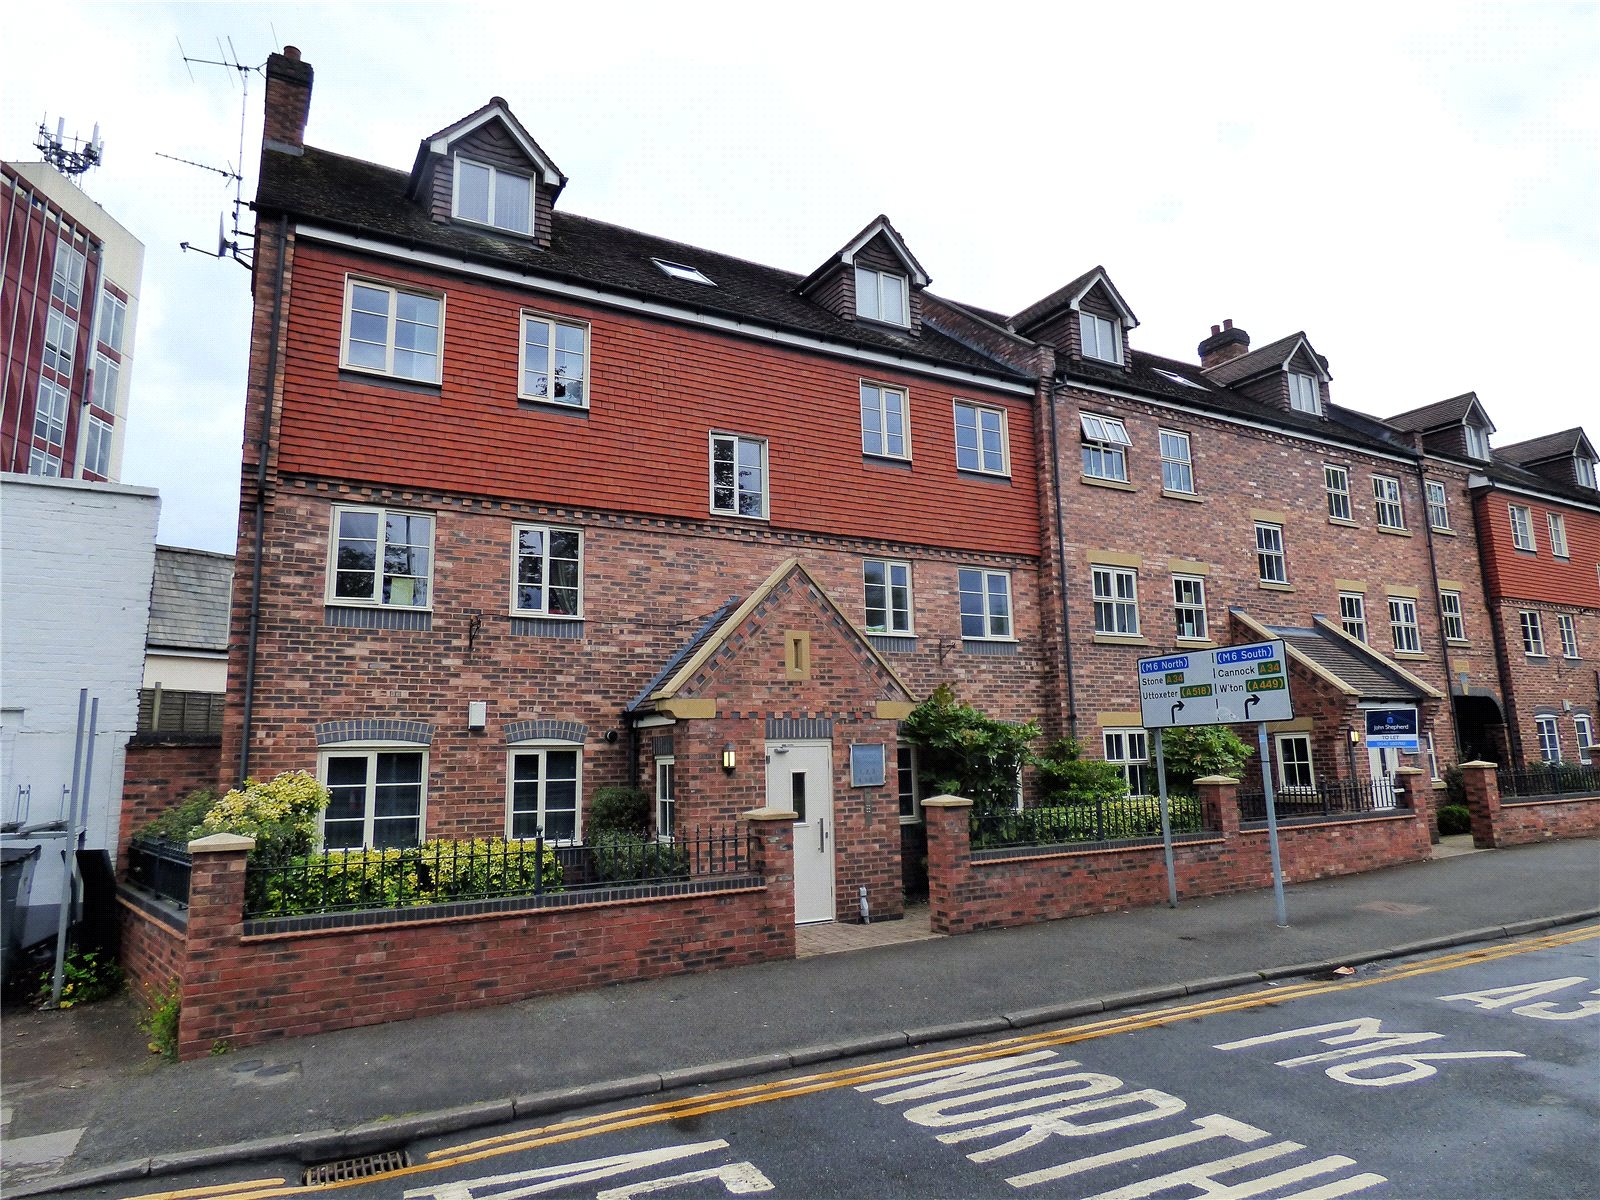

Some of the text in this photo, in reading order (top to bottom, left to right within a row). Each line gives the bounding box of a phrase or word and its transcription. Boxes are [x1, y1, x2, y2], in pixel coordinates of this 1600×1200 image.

[1241, 647, 1272, 660] South)
[1161, 657, 1188, 670] North)
[1218, 663, 1280, 678] Cannock A34
[1142, 674, 1183, 686] Stone A34
[1219, 678, 1284, 693] W'ton (A449)
[1143, 686, 1211, 700] Uttoxeter (A518)
[1212, 1016, 1526, 1086] M6
